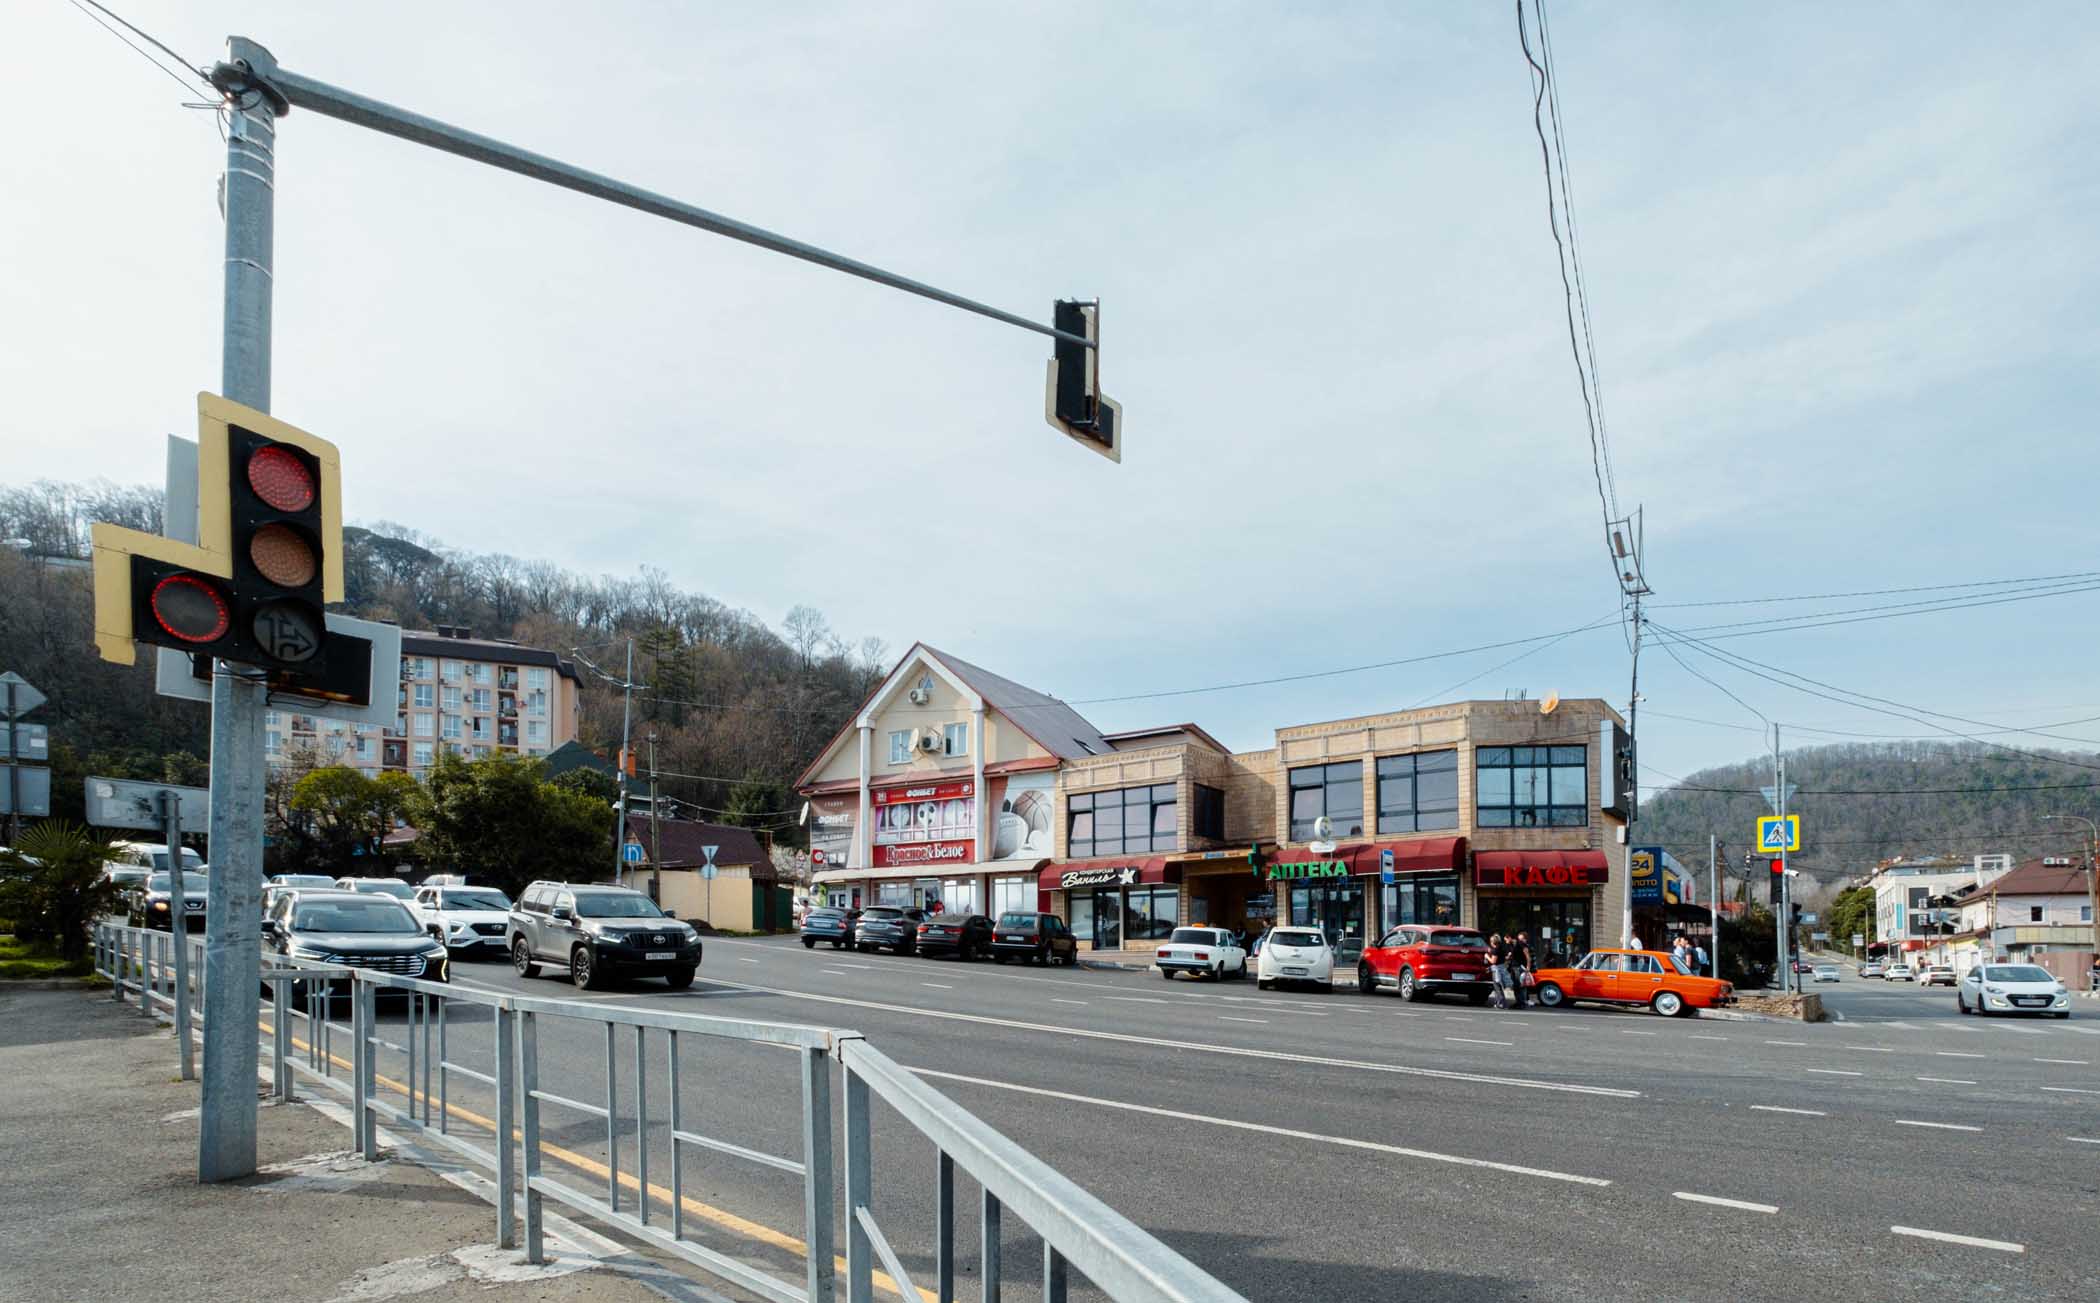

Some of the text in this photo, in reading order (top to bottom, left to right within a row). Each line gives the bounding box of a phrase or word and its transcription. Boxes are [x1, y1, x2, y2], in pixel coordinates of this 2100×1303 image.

[1062, 871, 1116, 887] Ваниль
[1268, 860, 1349, 880] АПТЕКА
[1503, 865, 1589, 886] КАФЕ
